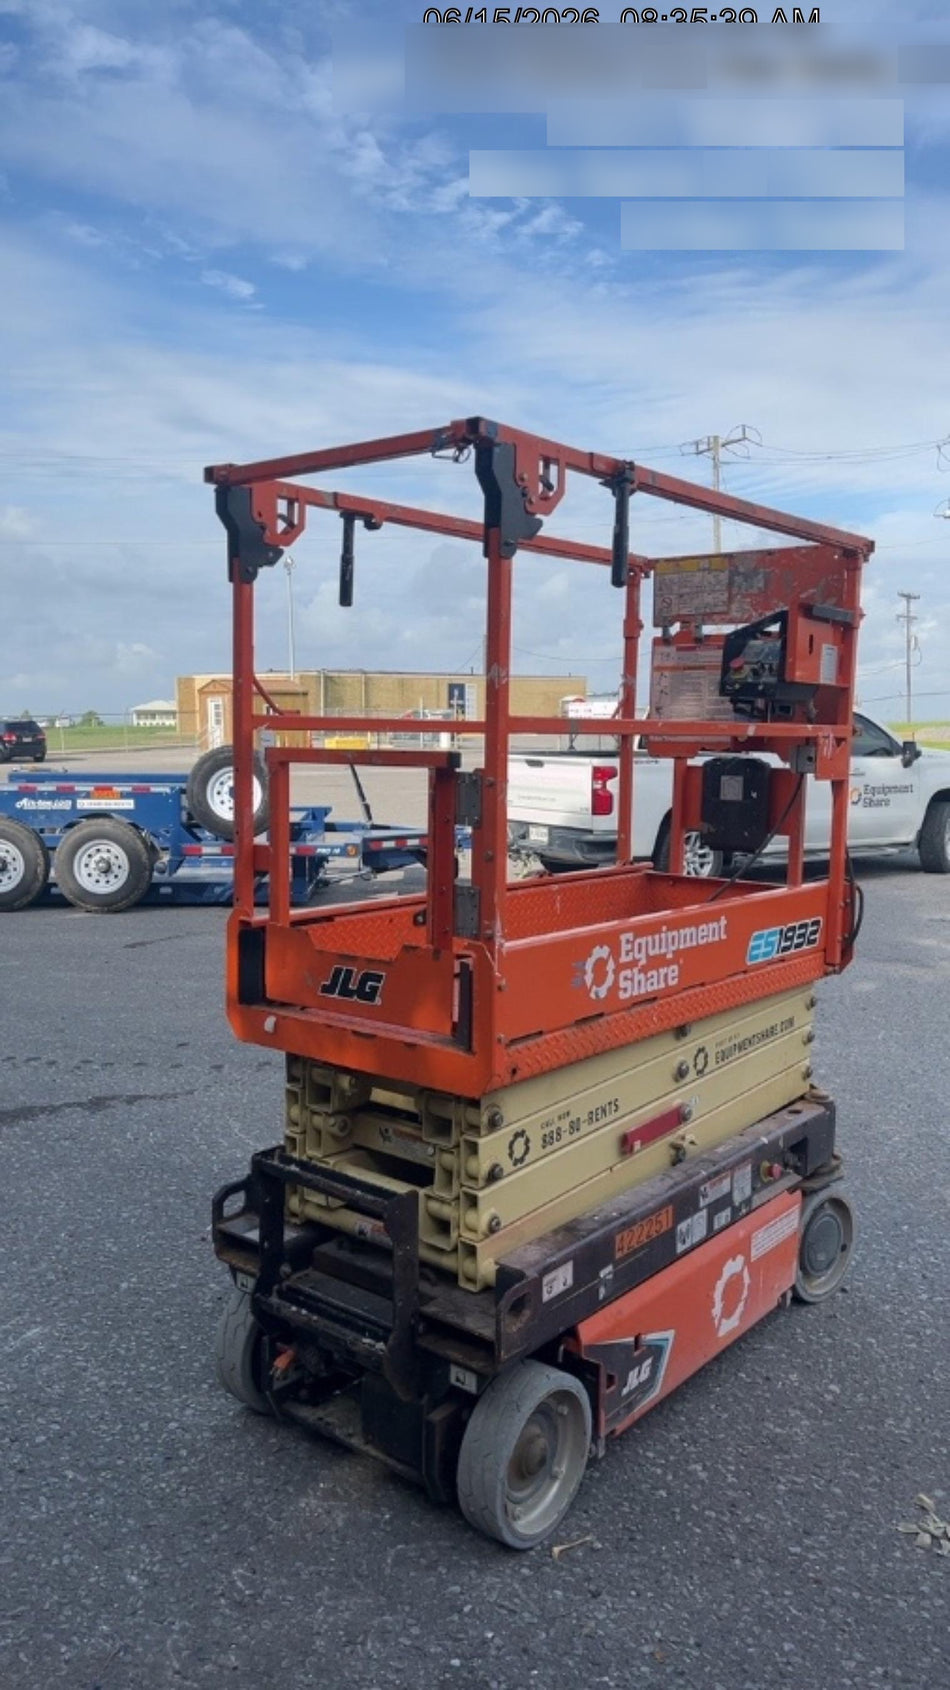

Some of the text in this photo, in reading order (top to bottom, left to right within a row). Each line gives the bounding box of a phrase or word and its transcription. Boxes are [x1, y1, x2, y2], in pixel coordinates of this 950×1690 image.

[863, 784, 913, 797] Equipment
[863, 797, 890, 808] Share
[619, 916, 727, 965] Equipment
[747, 918, 823, 964] ES1932
[319, 965, 385, 1005] JLG
[618, 963, 679, 1000] Share
[715, 1016, 795, 1065] EQUIPMENTSHARE.COM
[541, 1098, 619, 1149] 888-80-RENTS
[616, 1208, 672, 1253] 422251
[621, 1356, 654, 1397] JLG
